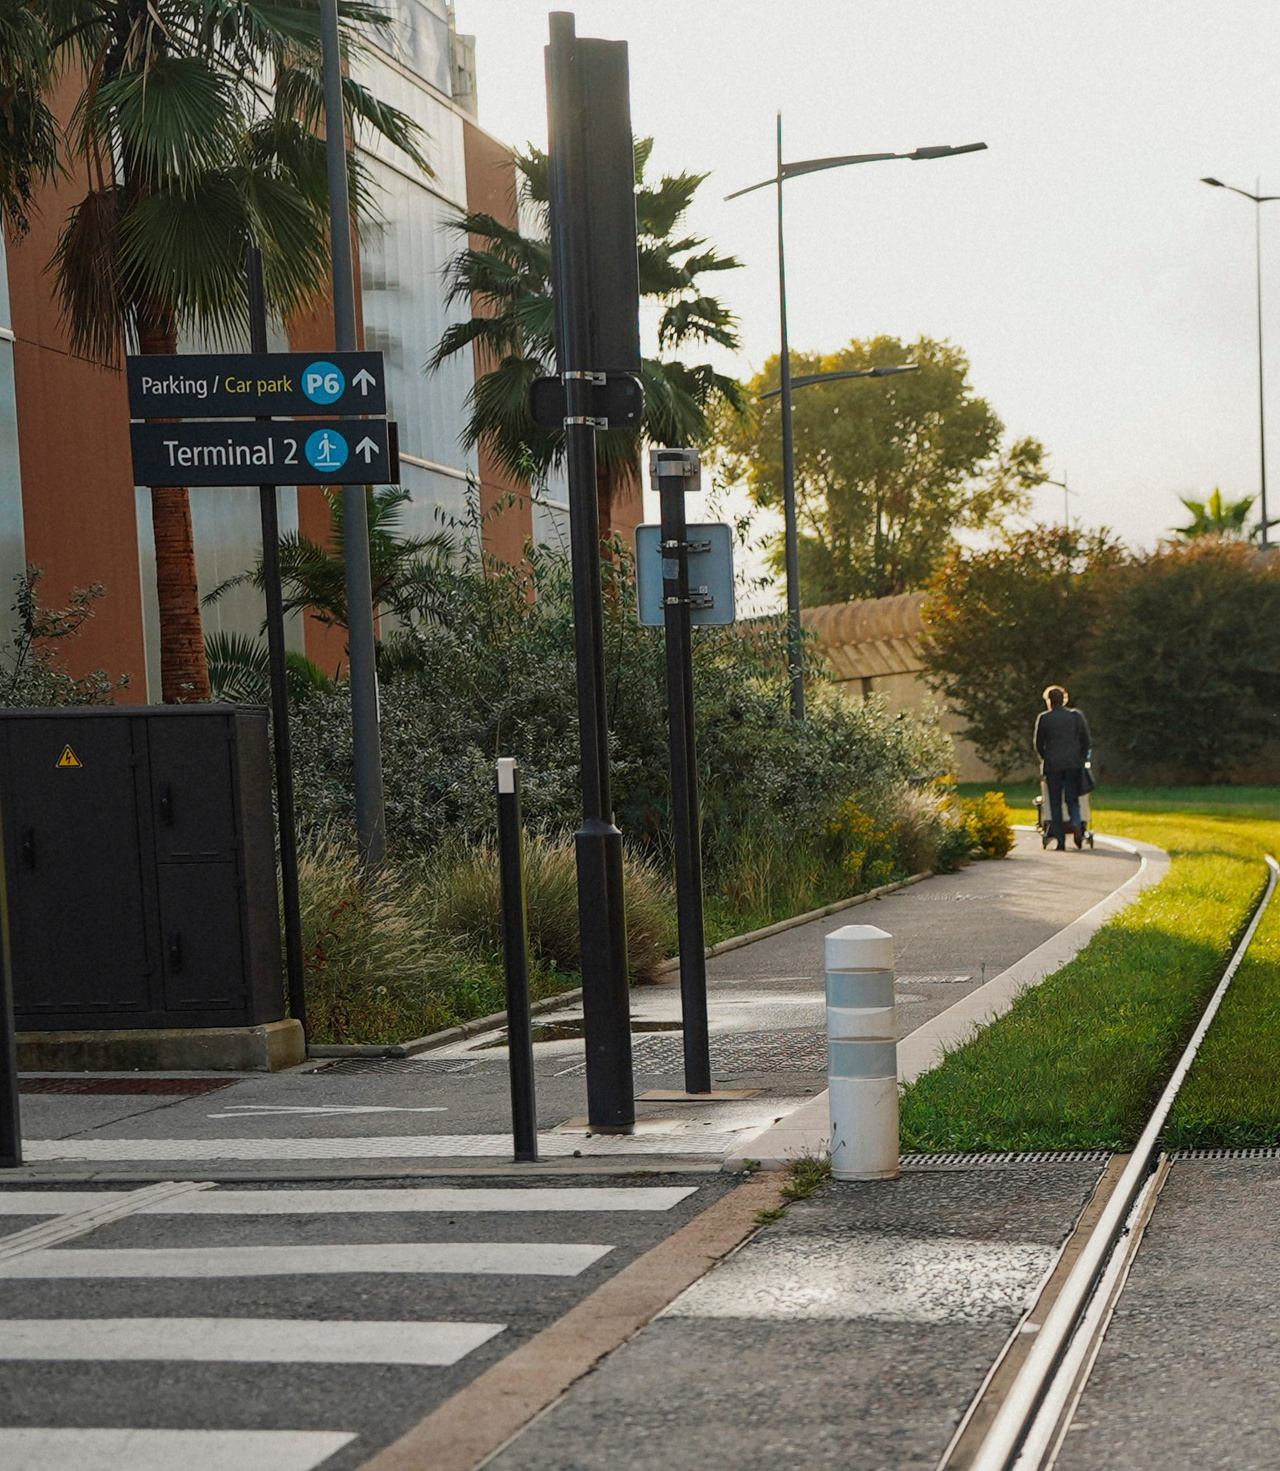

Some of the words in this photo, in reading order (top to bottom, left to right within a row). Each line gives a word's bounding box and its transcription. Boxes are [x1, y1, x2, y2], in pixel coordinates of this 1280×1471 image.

[142, 375, 207, 398] Parking
[212, 375, 220, 394] /
[224, 376, 252, 394] Car
[257, 375, 293, 397] park
[306, 372, 340, 394] P6
[163, 437, 275, 467] Terminal
[283, 438, 299, 466] 2
